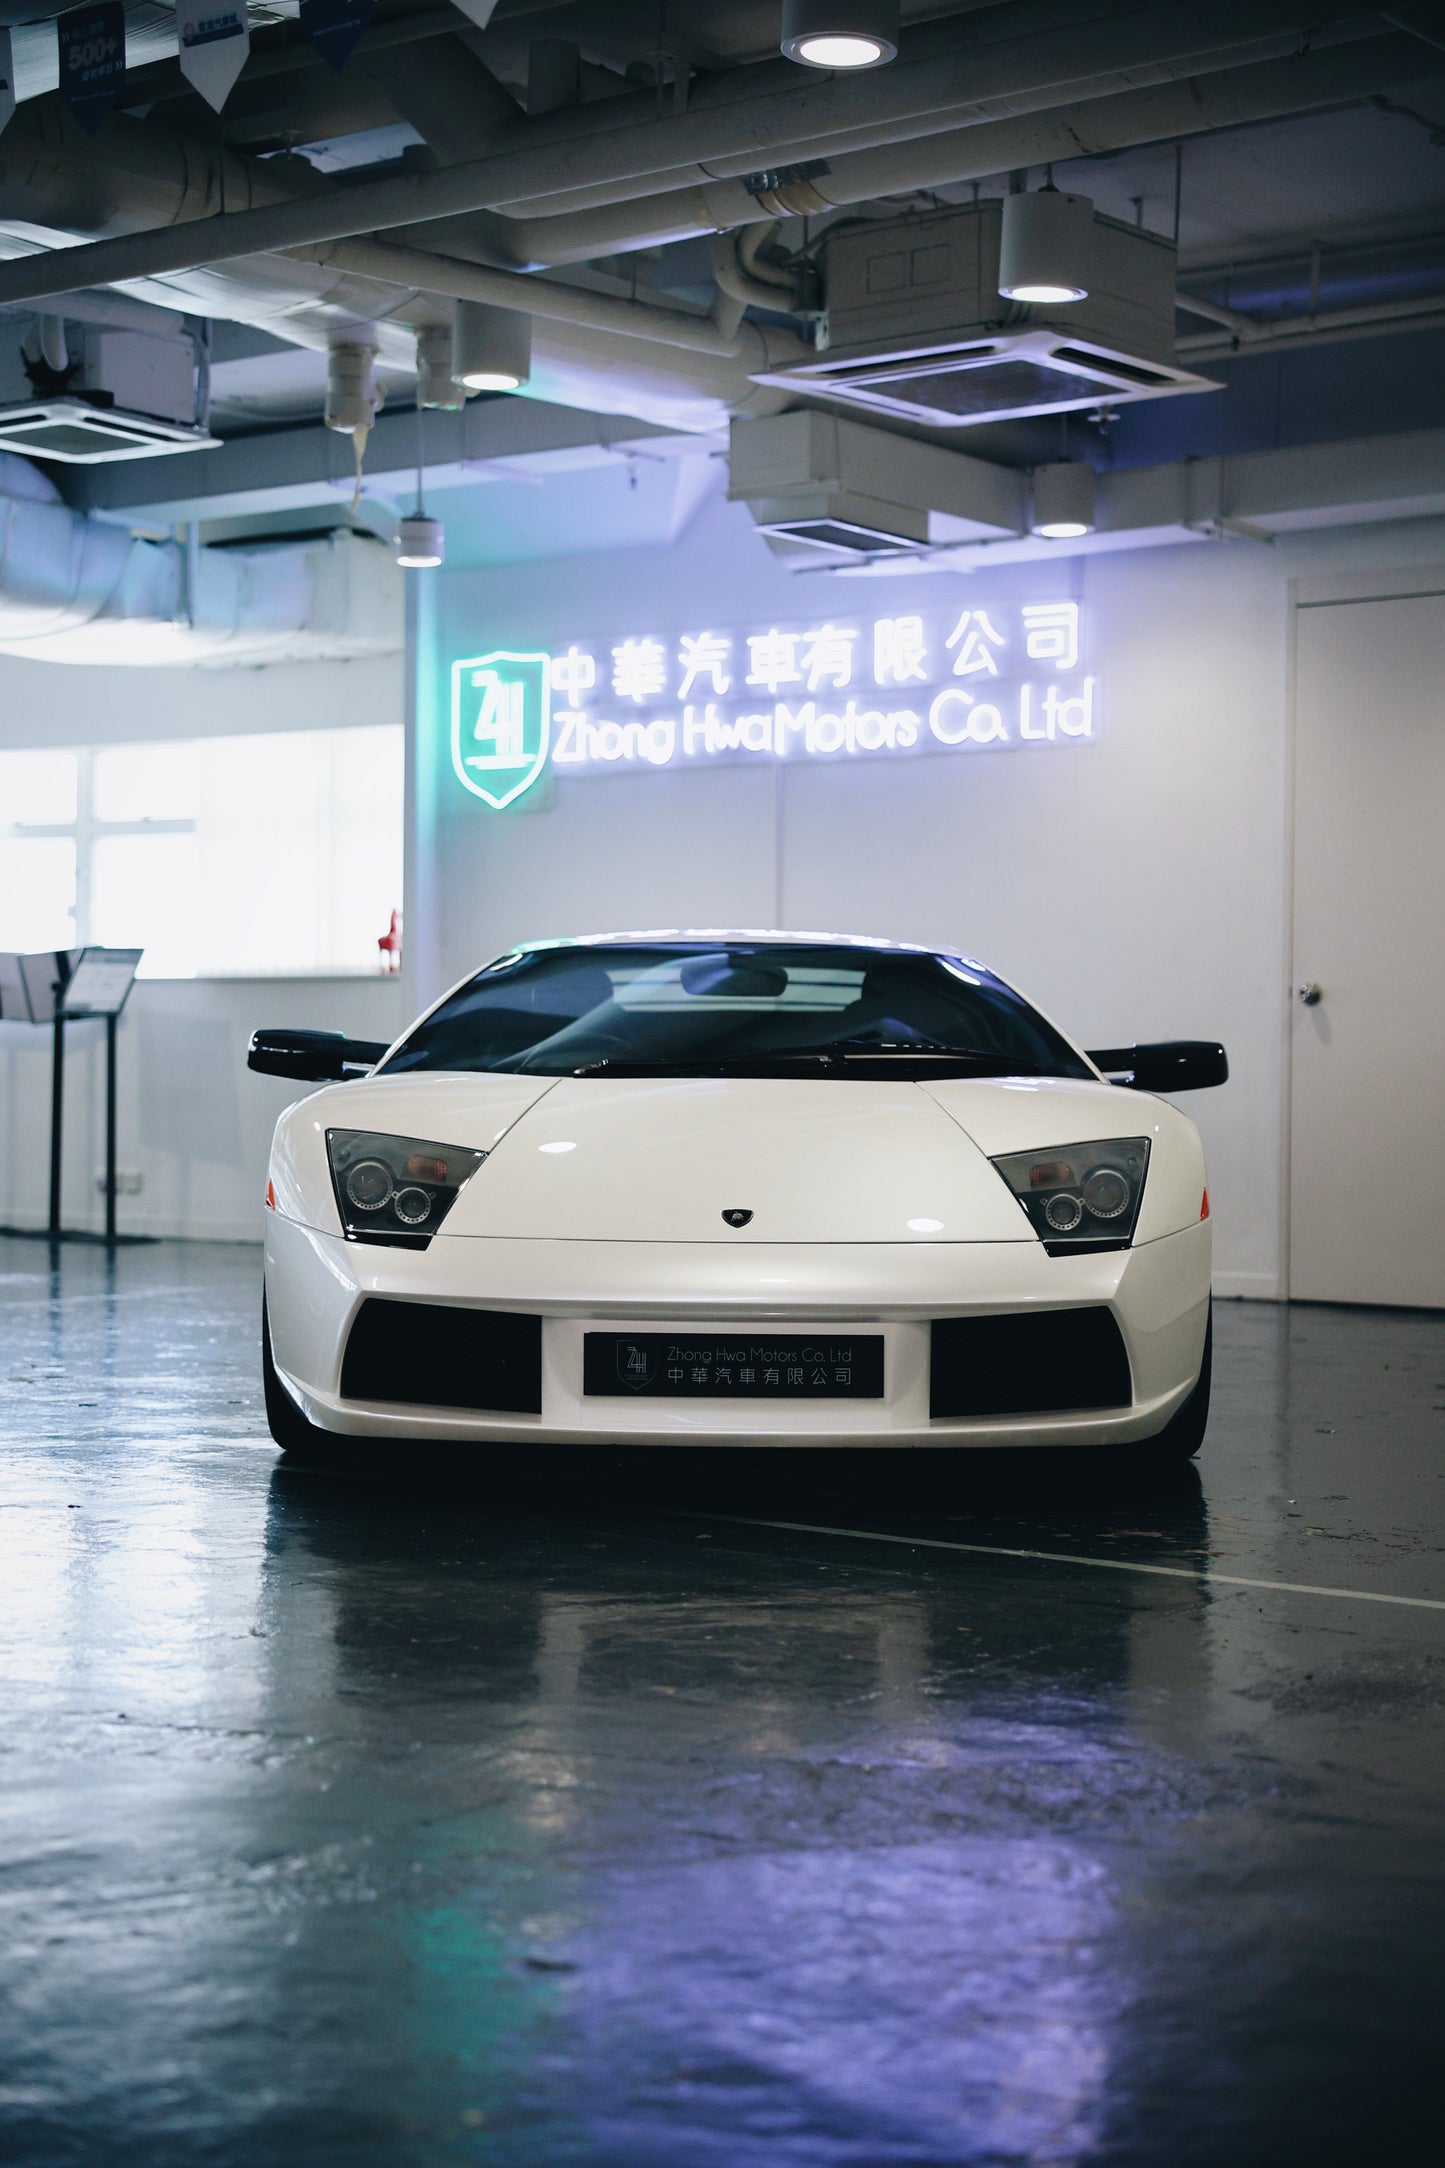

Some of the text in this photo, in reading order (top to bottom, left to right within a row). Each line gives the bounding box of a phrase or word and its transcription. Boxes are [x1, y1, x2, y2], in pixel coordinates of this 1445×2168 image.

[68, 38, 118, 70] 500+
[550, 602, 1080, 708] 中華汽車有限公司
[552, 712, 676, 764] Zhong
[683, 705, 773, 755] Hwa
[774, 701, 918, 754] Motors
[1020, 677, 1094, 740] Ltd
[667, 1347, 852, 1363] Zhong Hwa Motors Co. Ltd
[667, 1367, 852, 1385] 中華汽車有限公司
